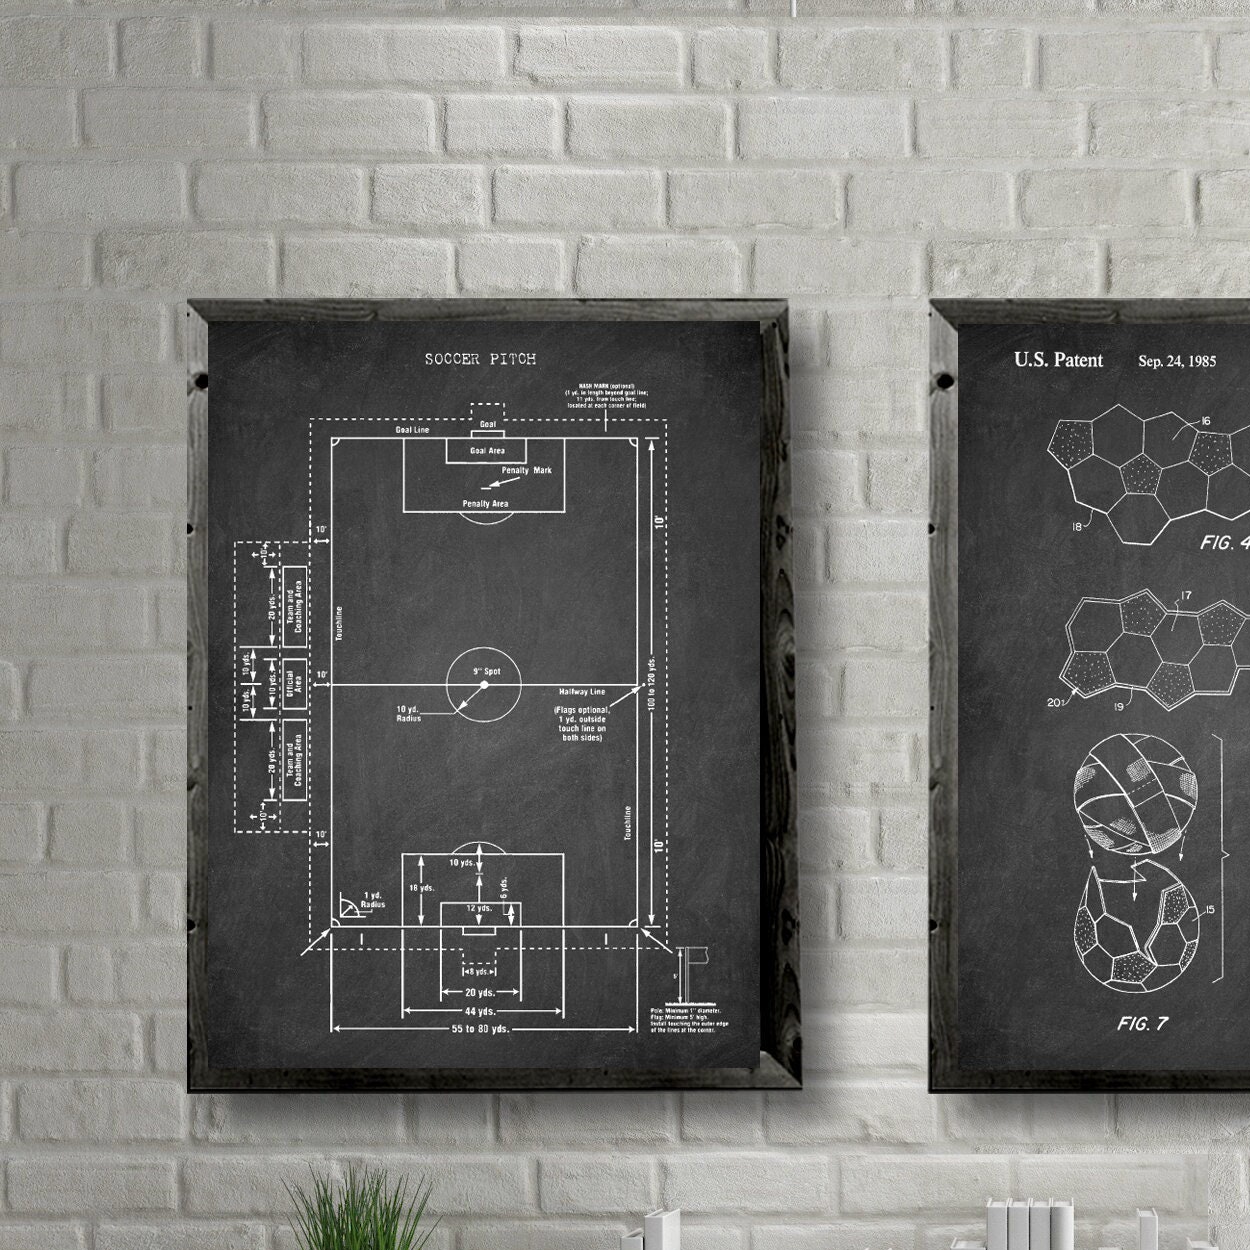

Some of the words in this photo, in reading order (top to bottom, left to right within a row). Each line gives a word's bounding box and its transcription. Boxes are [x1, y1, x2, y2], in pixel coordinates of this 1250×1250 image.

[425, 352, 480, 365] SOCCER
[490, 352, 537, 365] PITCH
[1014, 351, 1049, 367] U.S.
[1054, 351, 1104, 368] Patent
[1138, 355, 1164, 370] Sep.
[1166, 355, 1185, 369] 24,
[1189, 355, 1217, 368] 1985
[1202, 416, 1211, 426] 16
[396, 426, 412, 434] Goal
[414, 426, 430, 434] Line
[489, 447, 506, 455] Area
[502, 466, 529, 475] Penalty
[533, 466, 552, 474] Mark
[463, 500, 490, 509] Penalty
[492, 500, 509, 508] Area
[1072, 522, 1083, 532] 18
[1200, 534, 1235, 550] FIG.
[294, 581, 302, 598] Area
[1181, 590, 1193, 600] 17
[268, 594, 277, 609] yds.
[268, 611, 276, 621] 20
[294, 599, 303, 633] Coaching
[335, 606, 343, 641] Touchline
[647, 656, 657, 672] yds.
[242, 667, 249, 675] 10
[484, 667, 501, 676] Spot
[647, 673, 656, 687] 120
[269, 687, 276, 695] 10
[559, 688, 588, 697] Halfway
[242, 704, 249, 712] 10
[647, 697, 656, 711] 100
[1114, 702, 1125, 711] 19
[396, 705, 406, 713] 10
[407, 705, 419, 714] yd.
[396, 714, 422, 722] Radius
[566, 716, 577, 725] yd.
[294, 734, 302, 751] Area
[580, 734, 603, 743] sides)
[286, 743, 294, 756] and
[286, 761, 294, 777] Team
[294, 752, 303, 787] Coaching
[623, 805, 632, 841] Touchline
[460, 859, 476, 868] yds.
[420, 885, 435, 893] yds.
[371, 892, 382, 900] yd.
[477, 905, 493, 913] yds.
[1206, 904, 1216, 914] 15
[465, 988, 476, 997] 20
[478, 988, 496, 999] yds.
[465, 1007, 476, 1016] 44
[478, 1007, 496, 1017] yds.
[1117, 1016, 1150, 1032] FIG.
[1156, 1016, 1170, 1031] 7
[452, 1025, 463, 1033] 55
[466, 1025, 475, 1033] to
[478, 1025, 489, 1033] 80
[492, 1025, 510, 1036] yds.
